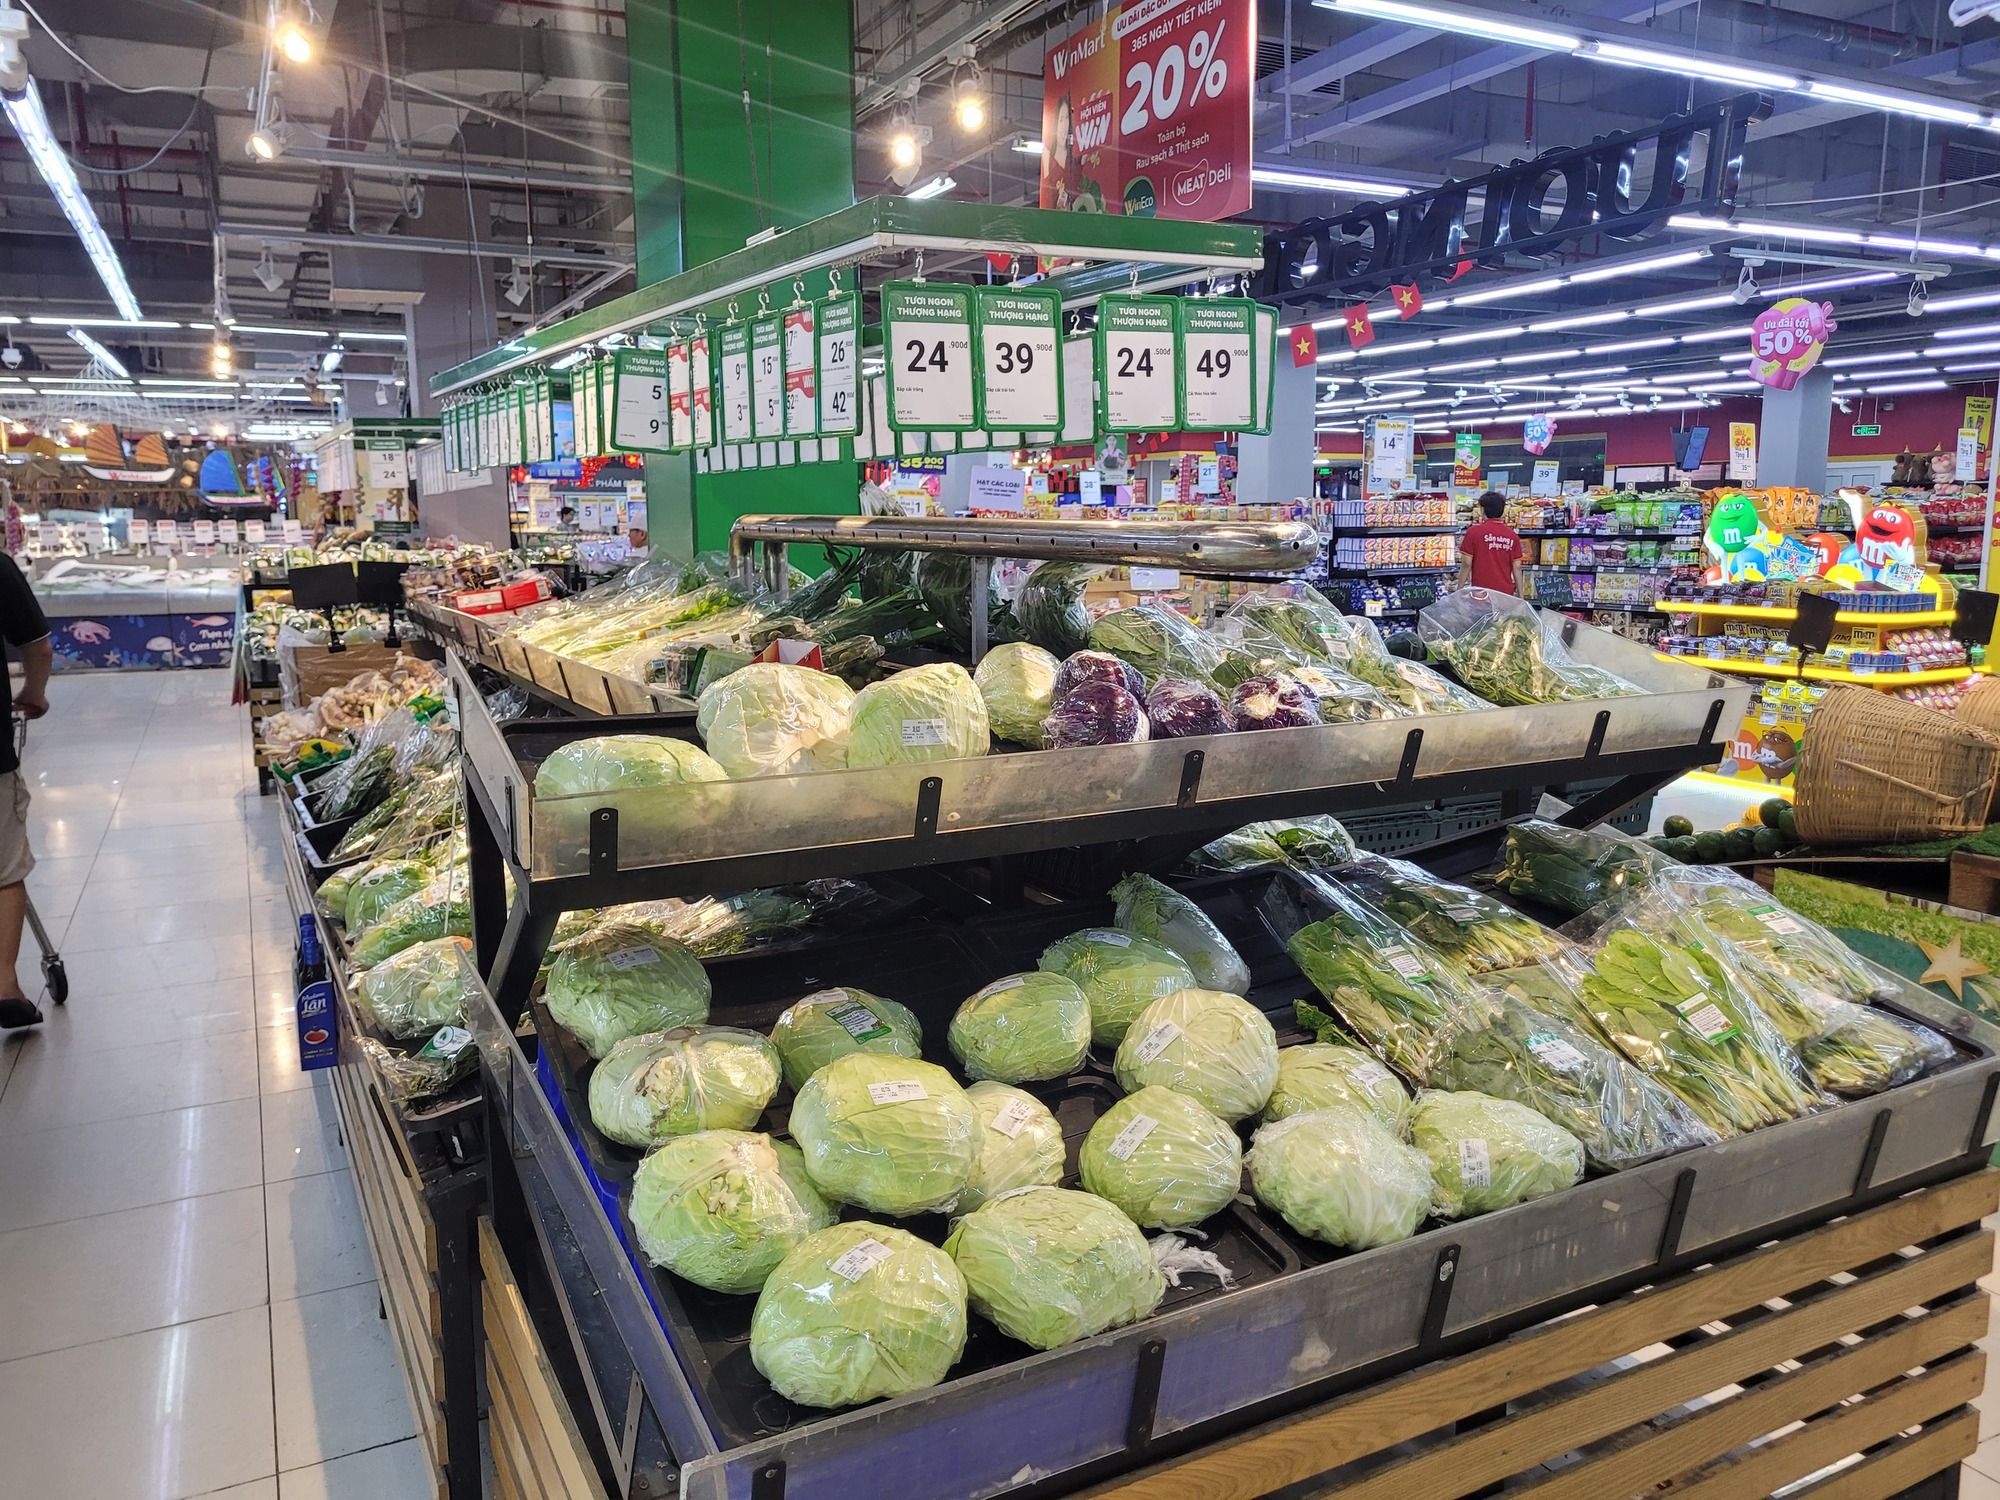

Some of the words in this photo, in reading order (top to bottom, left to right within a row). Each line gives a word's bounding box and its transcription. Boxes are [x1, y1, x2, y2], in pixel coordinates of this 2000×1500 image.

[1131, 34, 1148, 53] 365
[1149, 18, 1174, 43] NGÀY
[1176, 5, 1196, 28] TIẾT
[1120, 19, 1228, 136] 20%
[1158, 129, 1174, 144] Toàn
[1176, 122, 1186, 137] bộ
[1136, 159, 1149, 170] Rau
[1150, 149, 1167, 165] sạch
[1168, 146, 1174, 157] &
[1175, 140, 1190, 153] Thịt
[1191, 132, 1209, 148] sạch
[1177, 173, 1205, 196] MEAT
[1208, 162, 1231, 186] Deli
[904, 296, 926, 305] TƯƠI
[928, 297, 954, 307] NGON
[996, 300, 1016, 309] TƯƠI
[1017, 301, 1042, 311] NGON
[897, 307, 936, 318] THƯỢNG
[937, 308, 962, 318] HẠNG
[989, 310, 1024, 321] THƯỢNG
[1025, 311, 1049, 322] HẠNG
[1119, 307, 1137, 316] TƯƠI
[1138, 308, 1161, 316] NGON
[1196, 310, 1214, 318] TƯƠI
[1216, 311, 1238, 319] NGON
[1112, 318, 1145, 328] THƯỢNG
[1145, 318, 1168, 328] HẠNG
[1190, 320, 1222, 329] THƯỢNG
[1223, 320, 1244, 329] HẠNG
[1763, 321, 1776, 330] Ưu
[1778, 318, 1793, 328] đãi
[1795, 317, 1809, 328] tới
[1759, 329, 1813, 356] 50%
[831, 340, 844, 363] 26
[906, 340, 948, 373] 24
[995, 342, 1034, 374] 39
[625, 364, 655, 373] THƯỢNG
[762, 356, 772, 375] 15
[1117, 348, 1154, 377] 24
[1196, 349, 1231, 378] 49
[735, 363, 741, 381] 9
[652, 385, 662, 400] 5
[768, 399, 774, 416] 5
[833, 391, 846, 413] 42
[737, 404, 742, 421] 3
[650, 419, 659, 434] 9
[1382, 437, 1396, 449] 14
[382, 453, 394, 462] 18
[383, 470, 396, 479] 24
[1202, 468, 1211, 476] 21
[1348, 470, 1359, 480] 14
[1538, 470, 1550, 478] 39
[585, 506, 591, 517] 5
